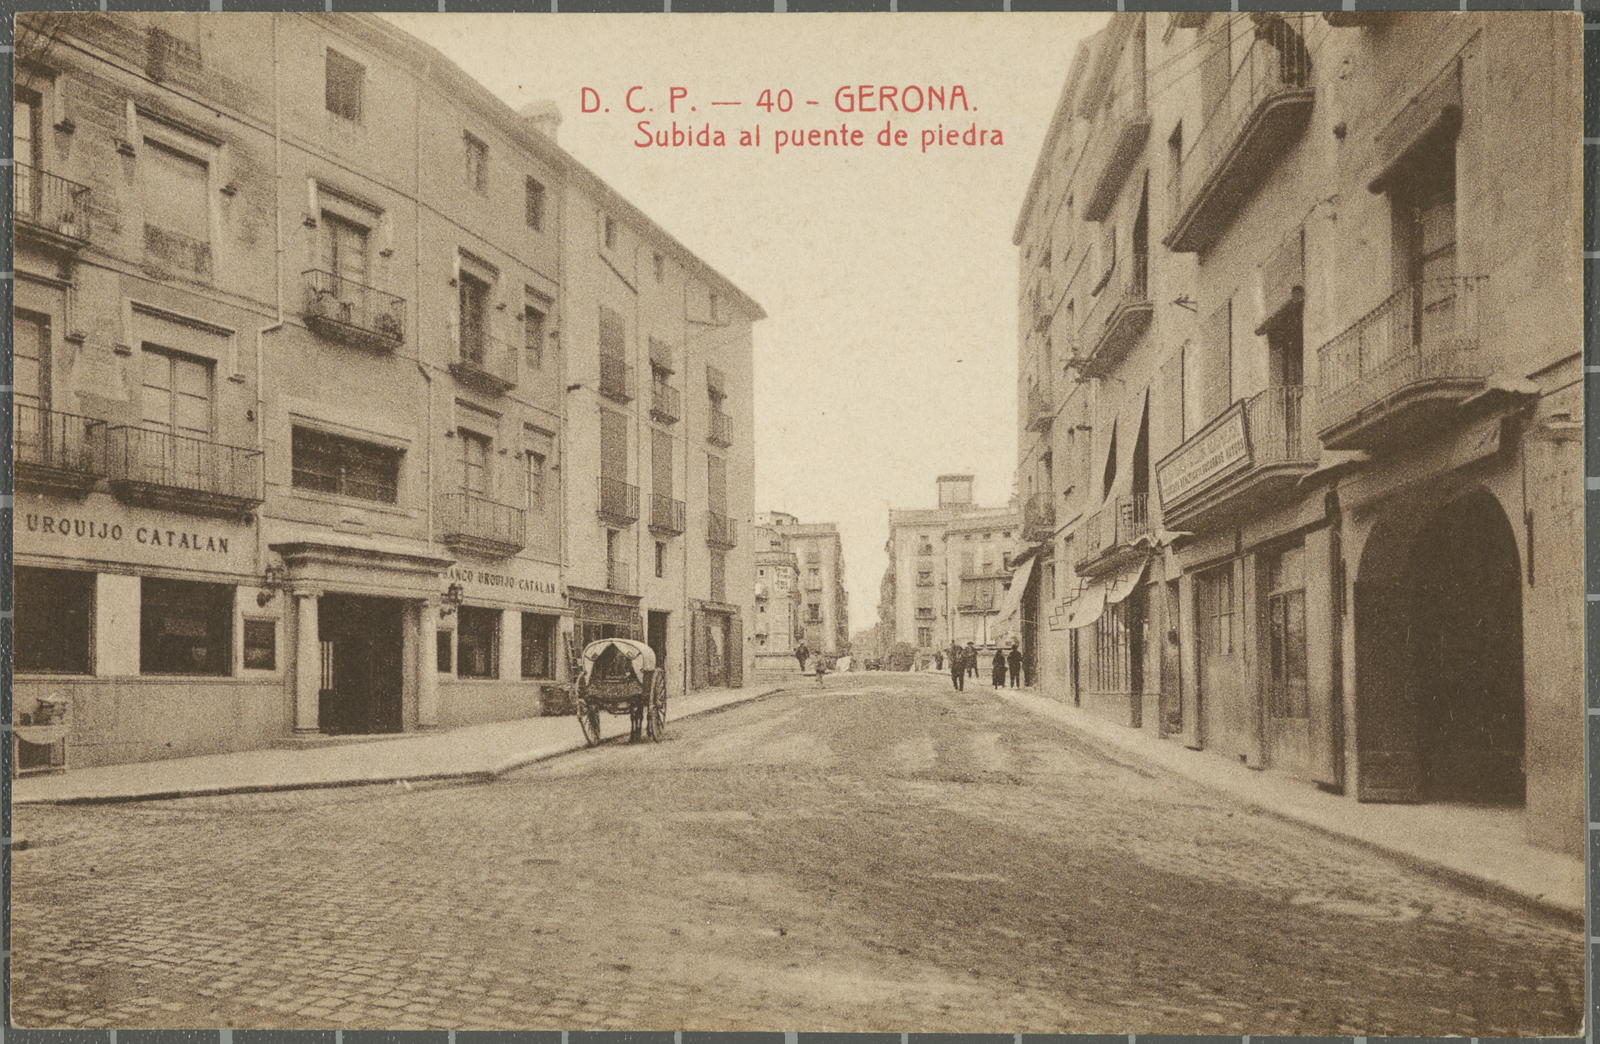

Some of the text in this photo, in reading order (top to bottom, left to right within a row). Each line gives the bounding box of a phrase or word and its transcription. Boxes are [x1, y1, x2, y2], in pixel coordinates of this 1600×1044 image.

[26, 513, 229, 553] URQUIJO CATALAN
[478, 571, 515, 588] URQUIJO
[519, 578, 556, 594] CATALAN
